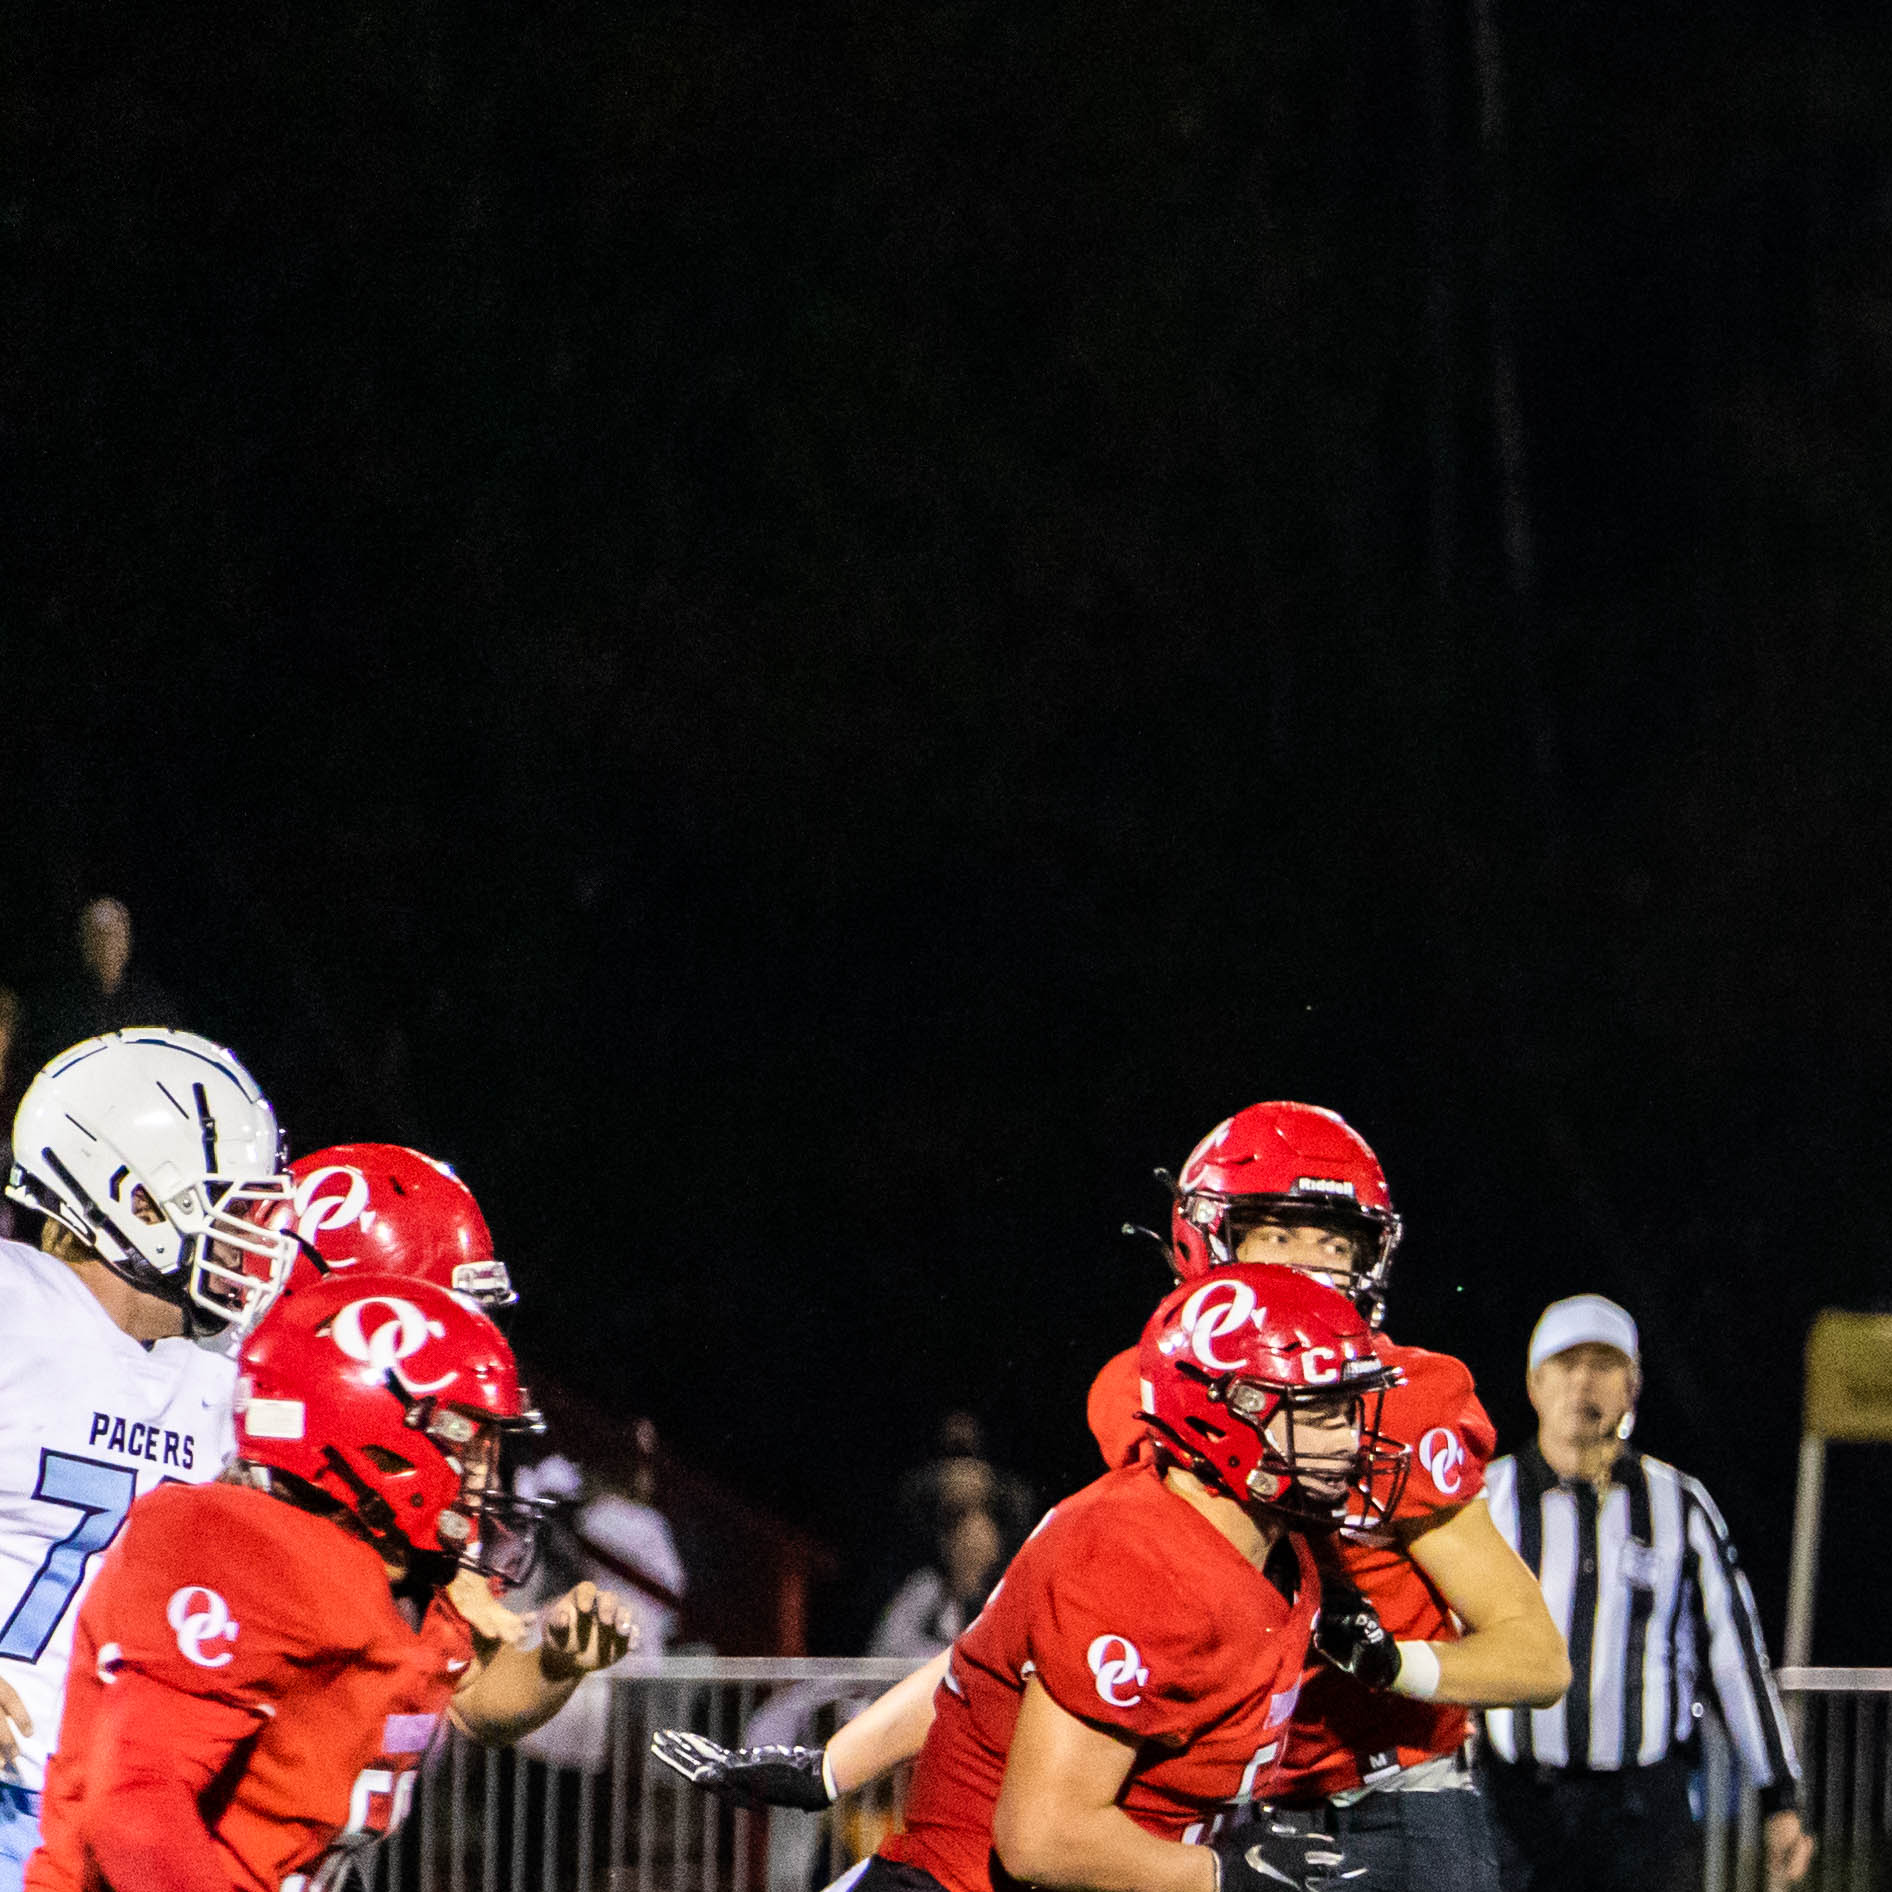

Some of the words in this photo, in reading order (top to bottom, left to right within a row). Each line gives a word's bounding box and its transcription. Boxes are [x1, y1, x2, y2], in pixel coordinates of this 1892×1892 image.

[331, 1296, 460, 1393] OC
[1181, 1279, 1267, 1370] OC
[1301, 1347, 1337, 1384] C
[89, 1411, 195, 1469] PACERS
[1419, 1427, 1465, 1494] OC
[166, 1585, 240, 1668] OC
[1087, 1634, 1150, 1707] OC
